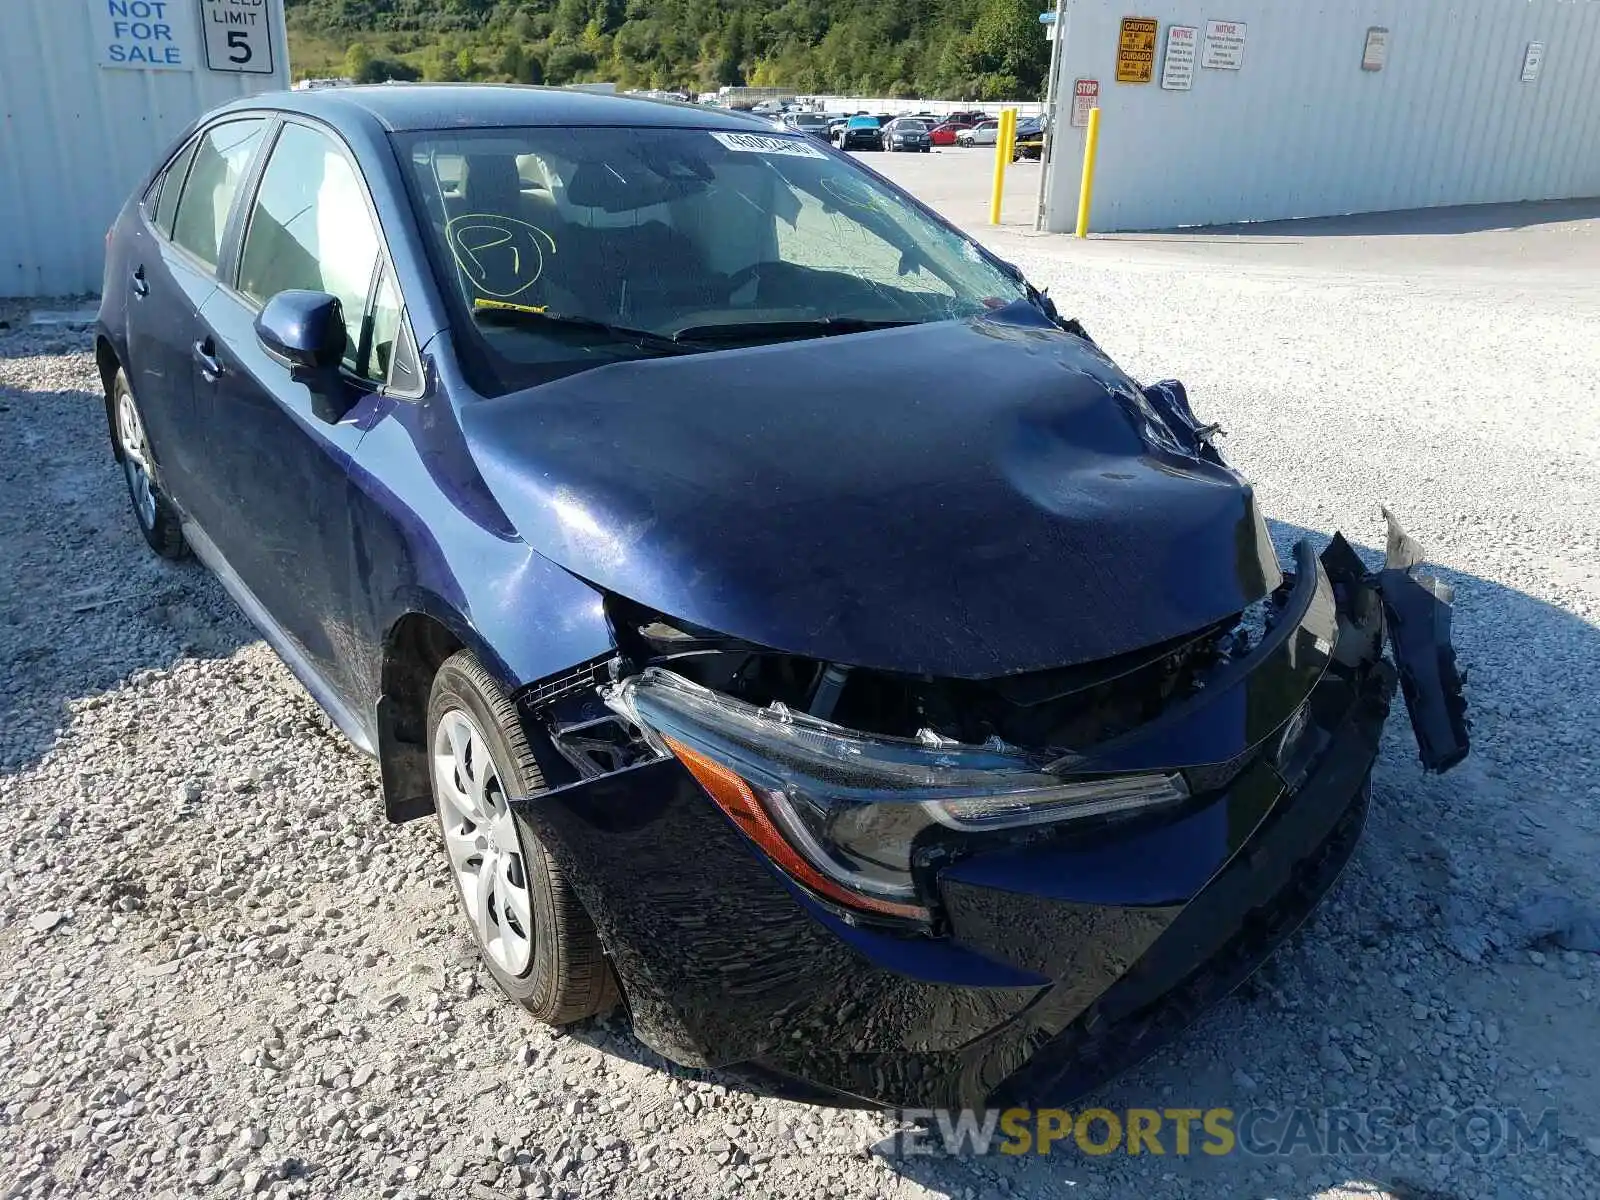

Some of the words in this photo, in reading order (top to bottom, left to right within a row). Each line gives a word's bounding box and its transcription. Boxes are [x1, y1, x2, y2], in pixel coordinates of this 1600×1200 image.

[109, 0, 167, 19] NOT
[213, 9, 257, 26] LIMIT
[113, 22, 174, 41] FOR
[1125, 22, 1154, 33] CAUTION
[109, 45, 182, 64] SALE
[227, 31, 252, 64] 5
[1077, 83, 1098, 95] STOP
